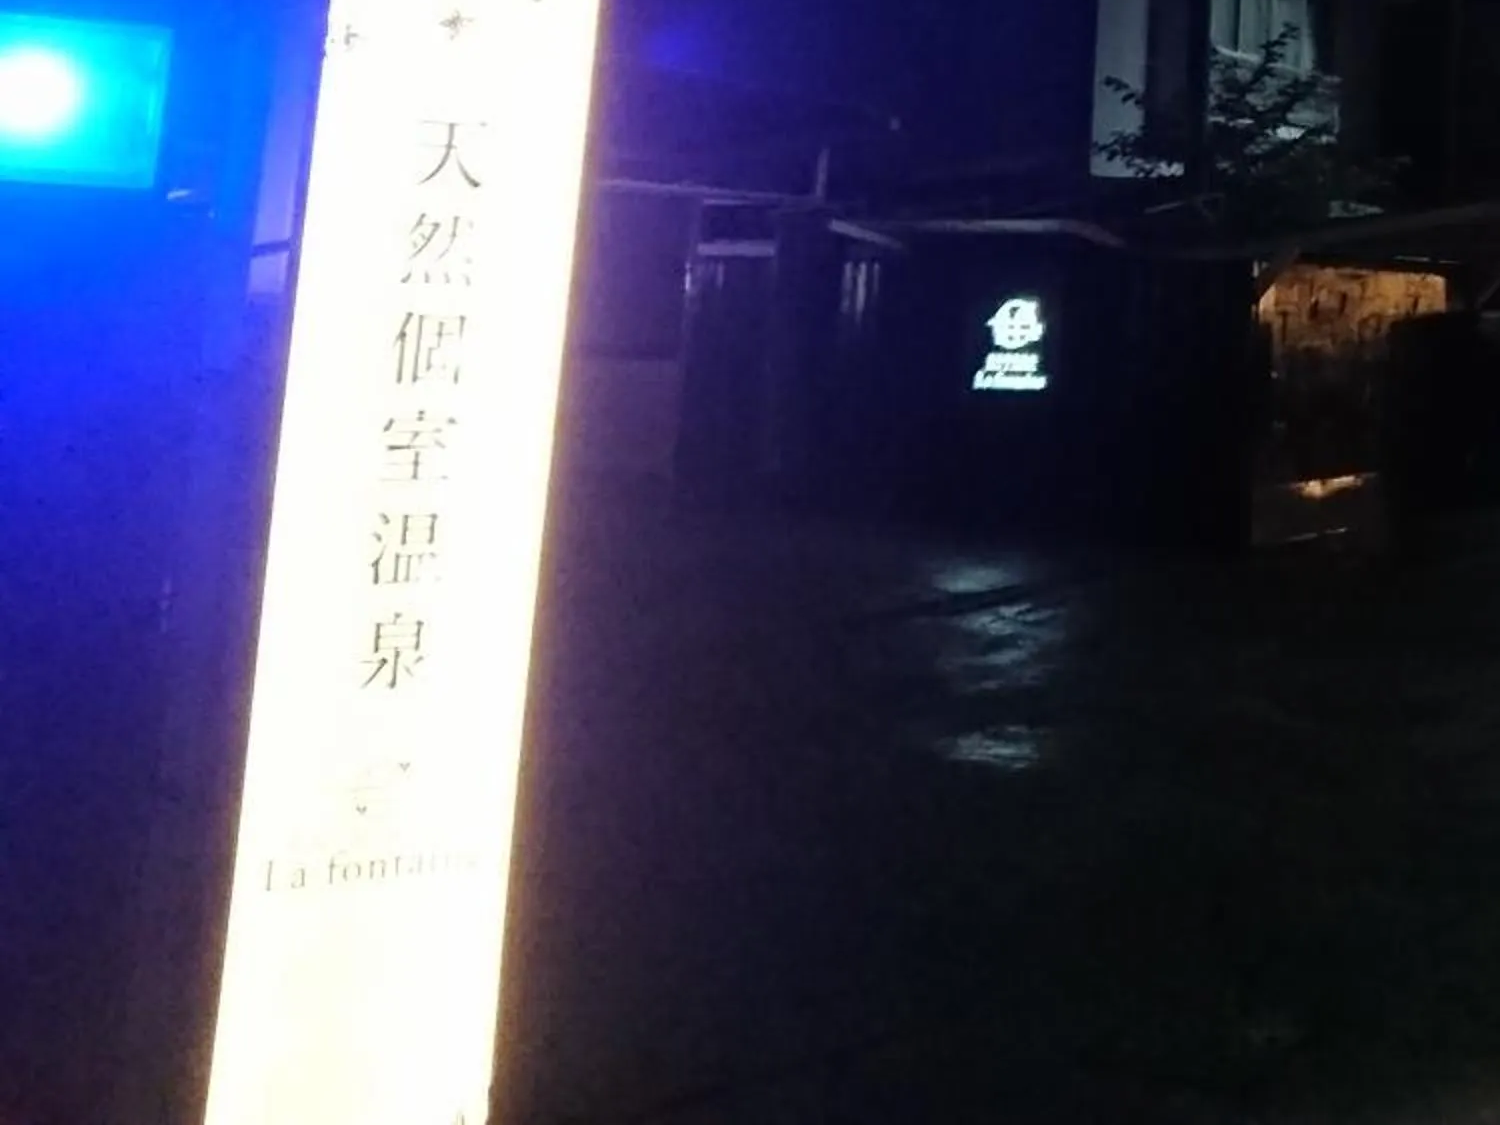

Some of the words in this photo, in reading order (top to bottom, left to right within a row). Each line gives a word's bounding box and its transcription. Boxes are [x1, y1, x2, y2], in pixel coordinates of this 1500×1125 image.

[359, 119, 488, 689] 天然個室温泉
